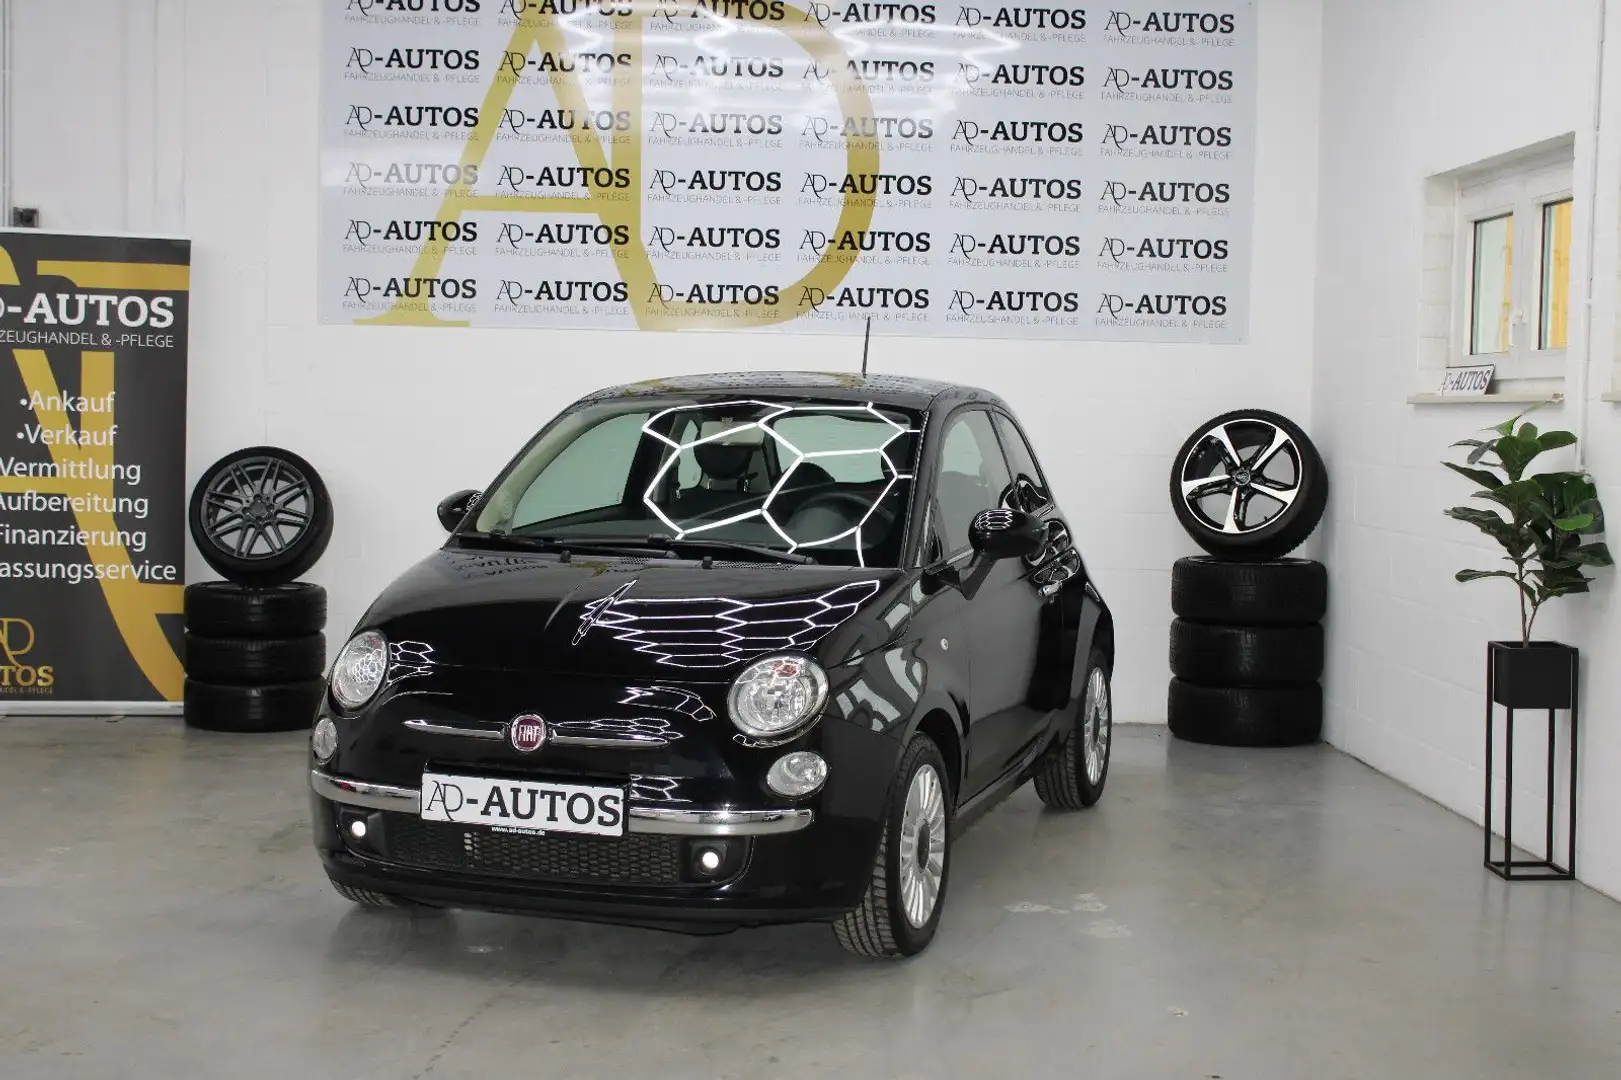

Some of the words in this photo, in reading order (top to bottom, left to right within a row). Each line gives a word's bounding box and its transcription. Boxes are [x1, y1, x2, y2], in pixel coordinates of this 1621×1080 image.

[345, 0, 481, 18] AD-AUTOS
[499, 0, 633, 23] AD-AUOS
[651, 0, 785, 27] ADAUTOS
[802, 1, 936, 31] AD-AUTOS
[953, 5, 1086, 35] AD-AUTOS
[1103, 9, 1235, 39] AD-AUTOS
[345, 46, 480, 76] AD-AUTOS
[498, 50, 632, 80] AD-AUTOS
[952, 62, 1084, 92] AD-AUTOS
[1101, 66, 1233, 96] AD-AUTOS
[344, 104, 479, 133] AD-AUTOS
[497, 107, 631, 137] AD-AUTOS
[649, 111, 783, 141] AD-AUTOS
[800, 115, 933, 145] AD-AUTOS
[951, 119, 1083, 149] AD-AUTOS
[1100, 123, 1232, 152] AD-AUTOS
[343, 161, 478, 190] AD-AUTOS
[496, 165, 631, 194] AD-AUTOS
[648, 169, 782, 198] AD-AUTOS
[799, 172, 932, 201] AD-AUTOS
[949, 176, 1082, 205] AD-AUTOS
[1099, 180, 1230, 209] AD-AUTOS
[343, 218, 478, 248] AD-AUTOS
[495, 222, 630, 251] AD-AUTOS
[647, 226, 781, 255] AD-AUTOS
[798, 229, 931, 258] AD-AUTOS
[948, 233, 1080, 262] AD-AUTOS
[1097, 236, 1229, 265] AD-AUTOS
[342, 276, 477, 305] AD-AUTOS
[494, 279, 629, 308] AD-AUTOS
[646, 282, 779, 311] AD-AUTOS
[797, 286, 930, 315] AD-AUTOS
[947, 289, 1079, 318] AD-AUTOS
[0, 292, 174, 328] -AUTOS
[1096, 293, 1227, 321] AD-AUTOS
[101, 333, 112, 346] &
[115, 334, 174, 348] -PFLEGE
[28, 390, 116, 413] Ankauf
[24, 424, 118, 447] Verkauf
[0, 457, 142, 486] Vermittlung
[518, 725, 540, 742] FIAT
[425, 780, 620, 827] AD-AUTOS
